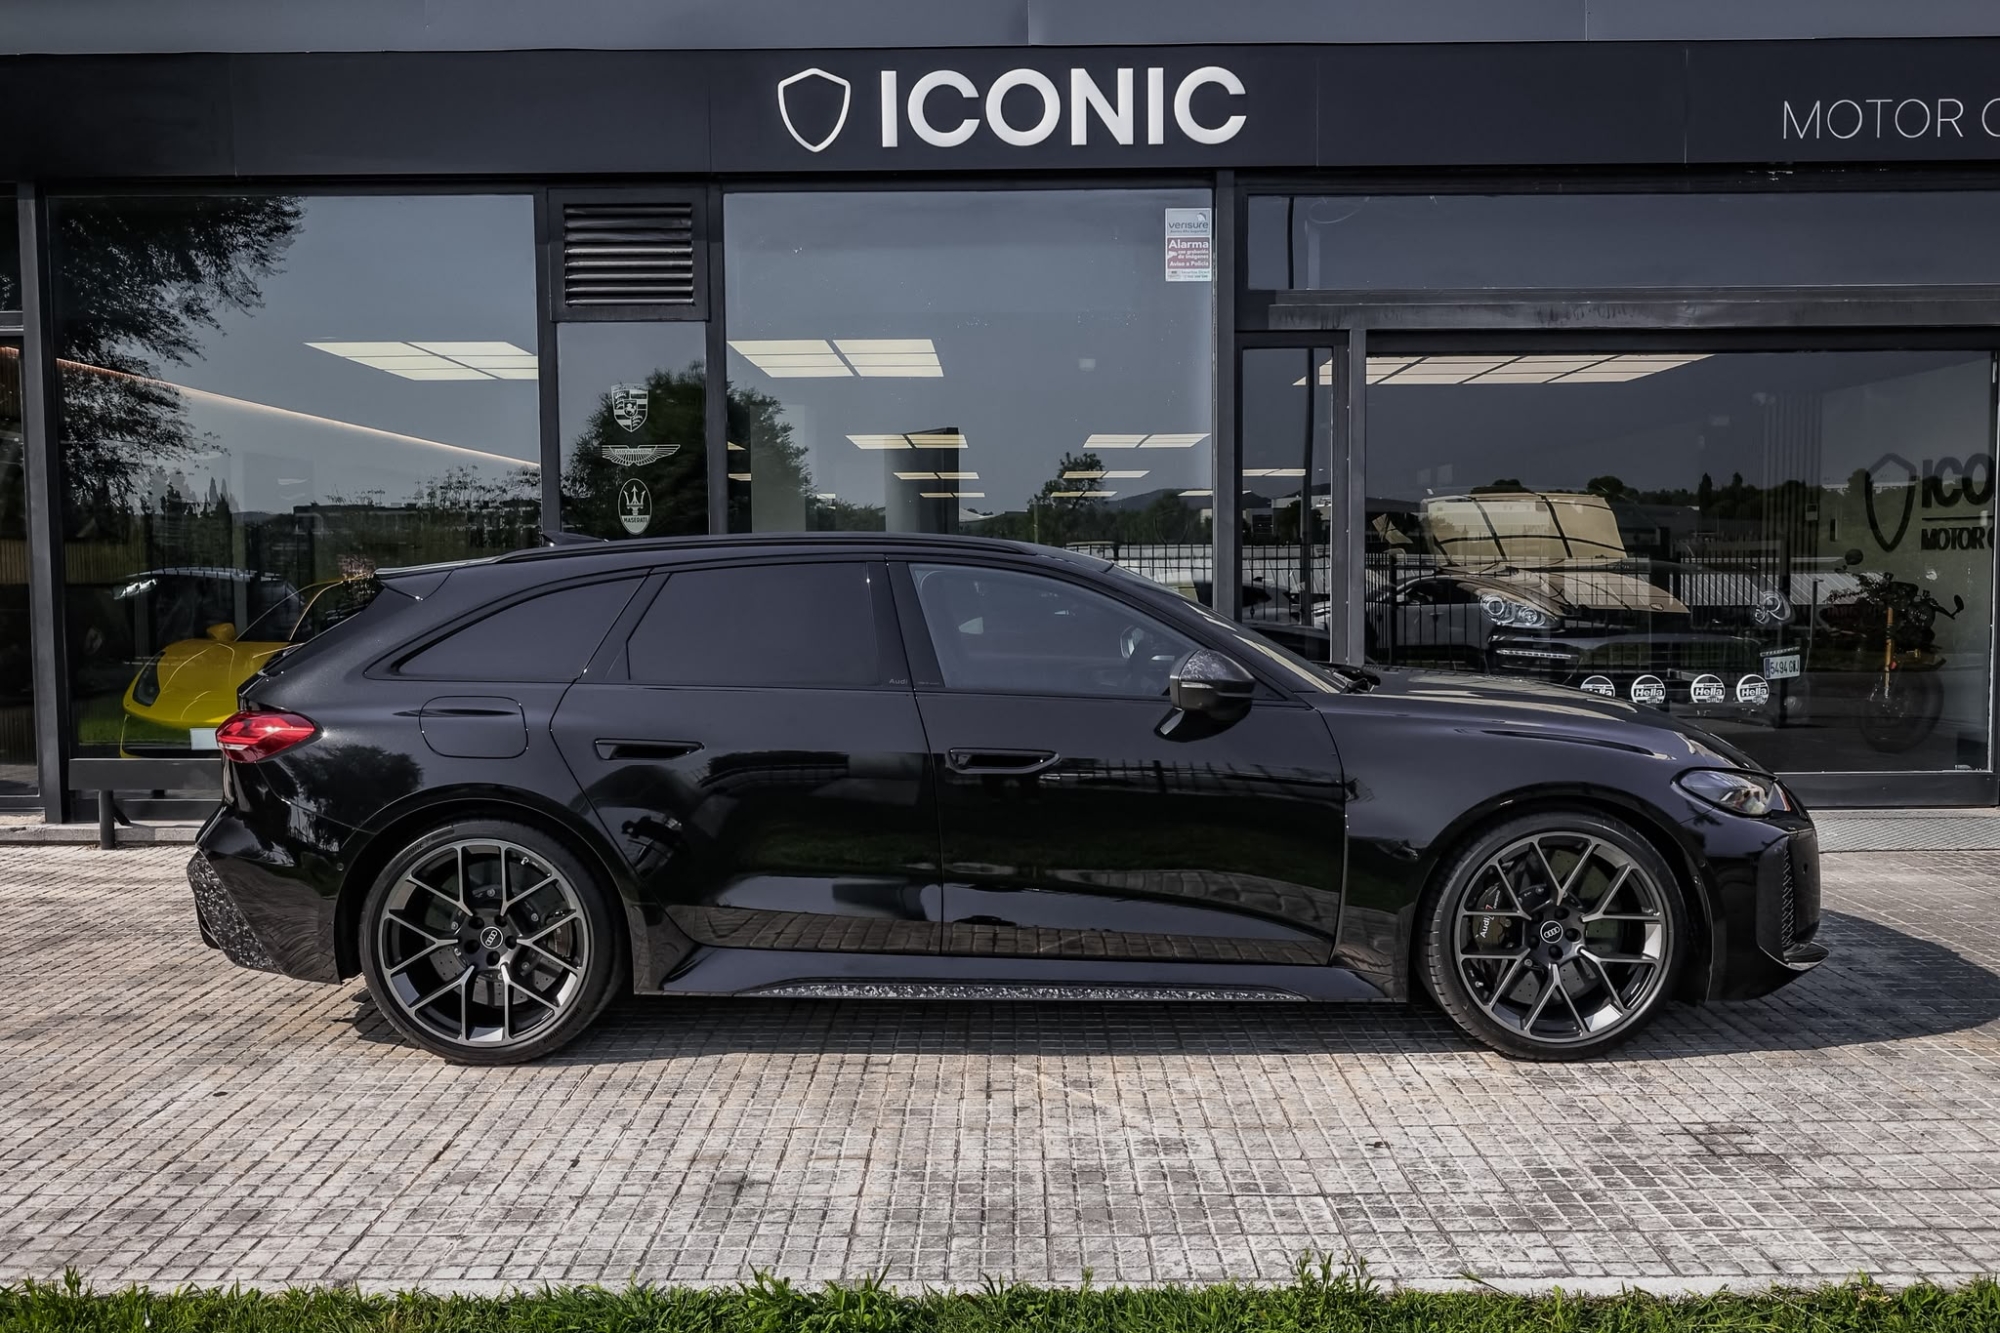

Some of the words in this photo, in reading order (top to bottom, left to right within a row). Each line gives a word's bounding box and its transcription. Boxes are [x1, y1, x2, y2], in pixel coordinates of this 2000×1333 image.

[880, 66, 1248, 148] ICONIC
[1783, 98, 1964, 140] MOTOR
[1168, 221, 1209, 229] verisure
[1168, 239, 1209, 249] Alarma
[1921, 453, 1995, 508] ICO
[1921, 527, 1985, 550] MOTOR
[1769, 661, 1788, 675] 5494
[1635, 688, 1663, 697] Hella
[1695, 687, 1723, 696] Hella
[1741, 687, 1767, 697] Hella
[1480, 916, 1491, 939] Audi
